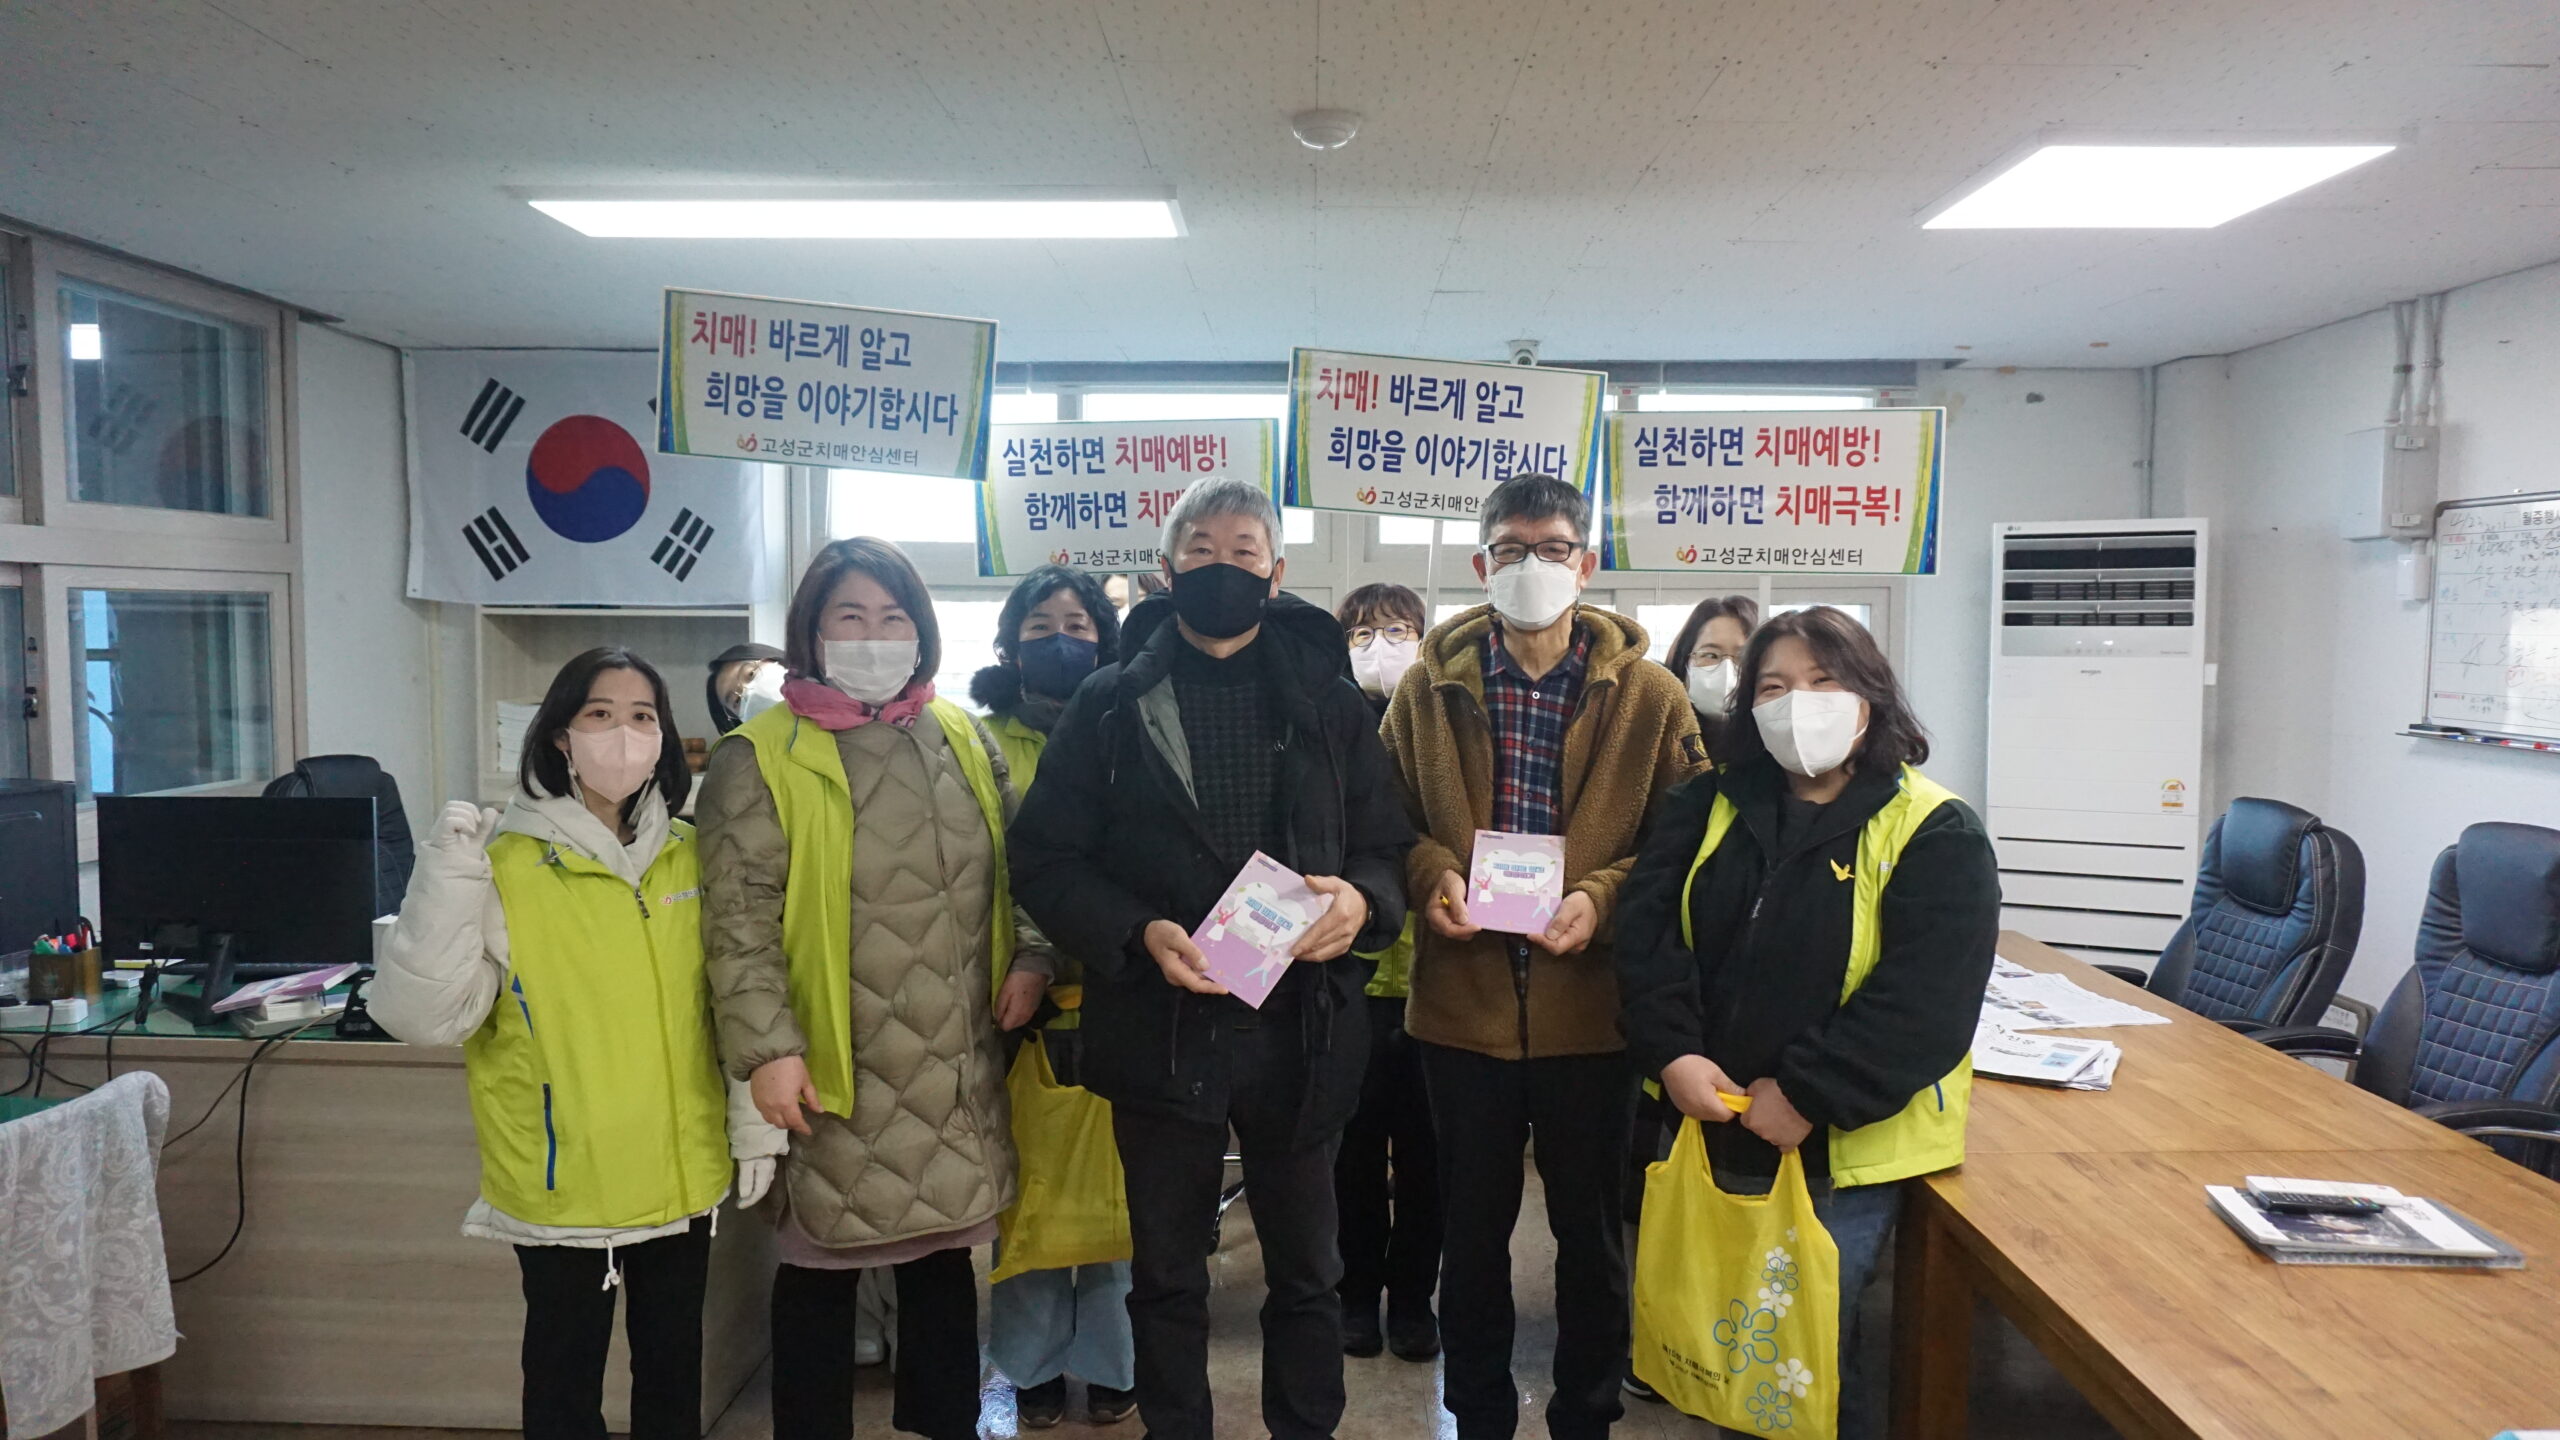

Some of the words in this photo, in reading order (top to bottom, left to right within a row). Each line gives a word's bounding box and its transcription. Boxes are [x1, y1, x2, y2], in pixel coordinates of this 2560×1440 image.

[691, 312, 757, 358] 치매!
[769, 319, 850, 367] 바르게
[860, 328, 911, 371] 알고
[704, 372, 788, 420] 희망을
[798, 381, 958, 436] 이야기합시다
[1317, 368, 1379, 413] 치매!
[1389, 374, 1466, 421] 바르게
[1476, 381, 1524, 424] 알고
[761, 437, 918, 467] 고성군치매안심센터
[1003, 436, 1106, 477] 실천하면
[1115, 434, 1227, 473] 치매예방!
[1328, 426, 1406, 473] 희망을
[1416, 433, 1568, 482] 이야기합시다
[1634, 426, 1744, 467] 실천하면
[1755, 426, 1881, 467] 치매예방!
[1024, 490, 1128, 531] 함께하면
[1379, 490, 1488, 513] 고성군치매안
[1654, 484, 1764, 525] 함께하면
[1775, 484, 1901, 526] 치매극복!
[1701, 547, 1863, 567] 고성군치매안심센터
